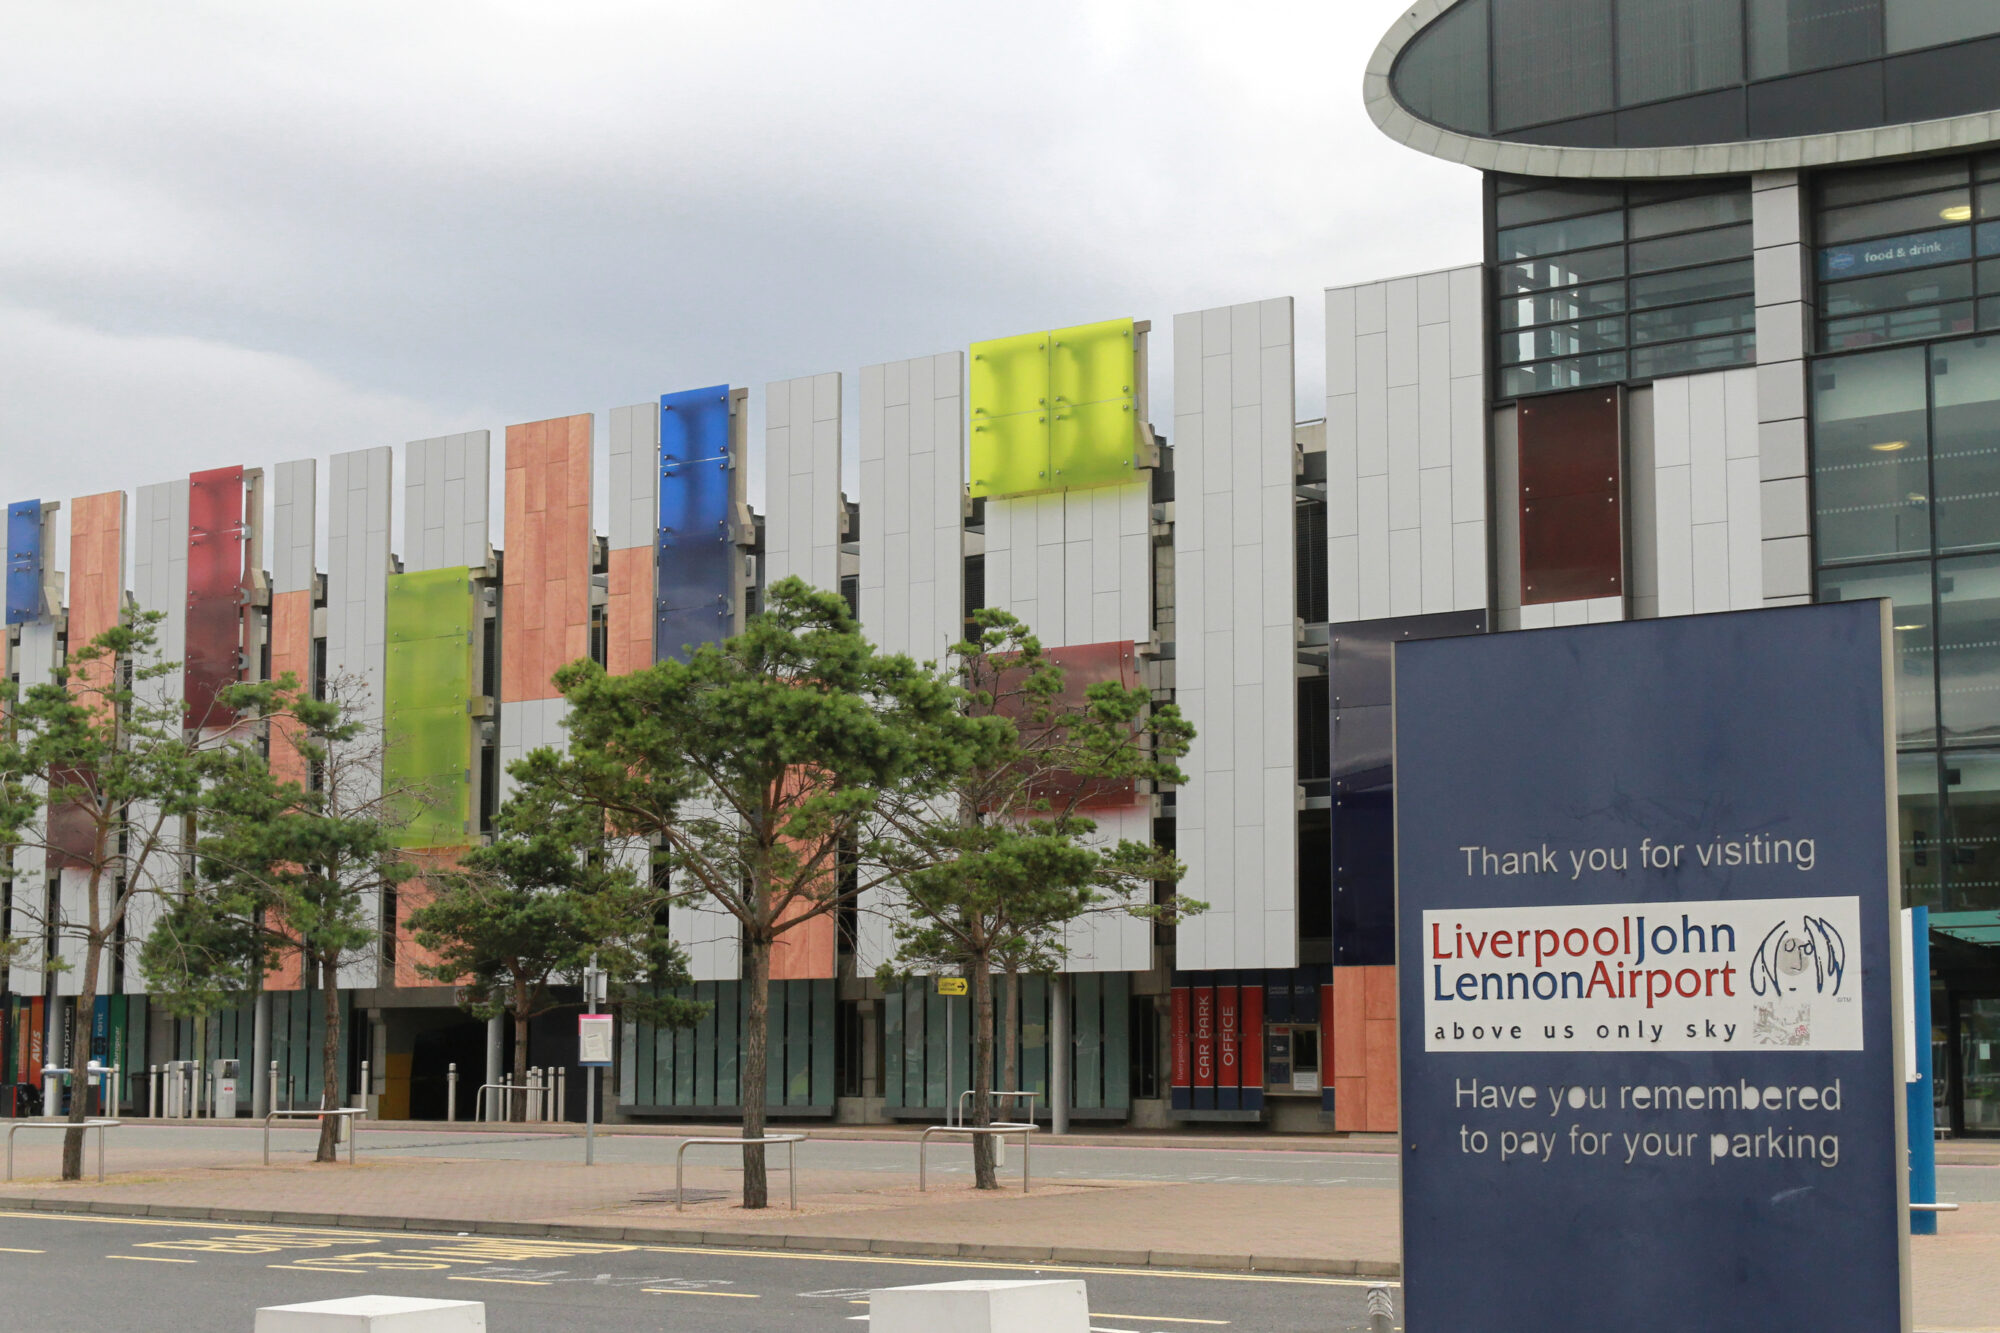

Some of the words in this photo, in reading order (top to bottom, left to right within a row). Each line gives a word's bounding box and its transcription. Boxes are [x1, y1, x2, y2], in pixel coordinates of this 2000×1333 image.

[1864, 248, 1893, 262] food
[1896, 247, 1906, 258] &
[1909, 241, 1941, 256] drink
[1459, 843, 1558, 876] Thank
[1569, 847, 1628, 880] you
[1639, 838, 1685, 868] for
[1696, 832, 1816, 871] visiting
[1199, 995, 1209, 1039] PARK
[1434, 1021, 1523, 1041] above
[1543, 1024, 1575, 1040] us
[1596, 1019, 1664, 1044] only
[1686, 1018, 1738, 1043] sky
[32, 1030, 41, 1063] AVIS
[1223, 1006, 1234, 1066] OFFICE
[1199, 1043, 1210, 1079] CAR
[1455, 1078, 1537, 1109] Have
[1549, 1086, 1607, 1117] you
[1620, 1078, 1841, 1111] remembered
[1459, 1124, 1488, 1154] to
[1501, 1131, 1556, 1162] pay
[1568, 1124, 1612, 1155] for
[1623, 1132, 1699, 1164] your
[1710, 1126, 1840, 1168] parking
[133, 1234, 381, 1253] BUS
